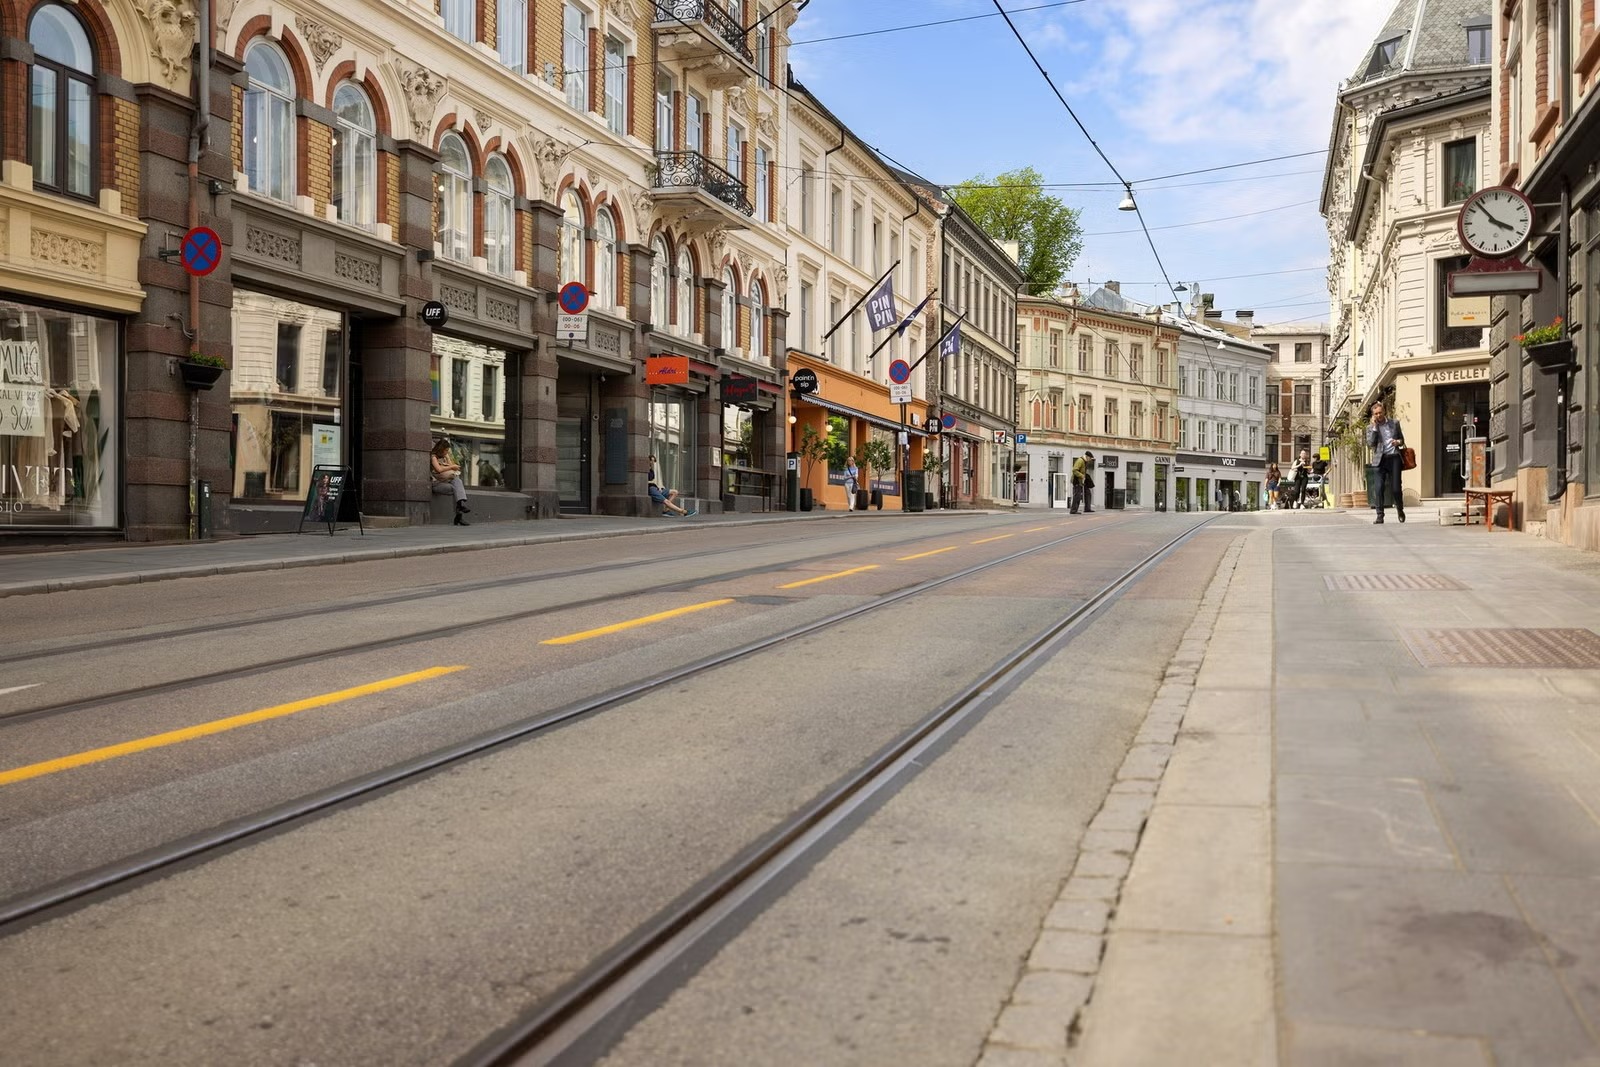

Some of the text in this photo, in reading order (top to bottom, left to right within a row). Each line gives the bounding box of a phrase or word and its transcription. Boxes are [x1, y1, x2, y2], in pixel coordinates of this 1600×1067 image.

[872, 295, 890, 313] PIN
[426, 308, 441, 316] UFF
[874, 309, 893, 327] PIN
[1425, 368, 1486, 382] KASTELLET
[1018, 434, 1025, 443] P
[788, 460, 795, 468] P
[1222, 458, 1236, 466] VOLT
